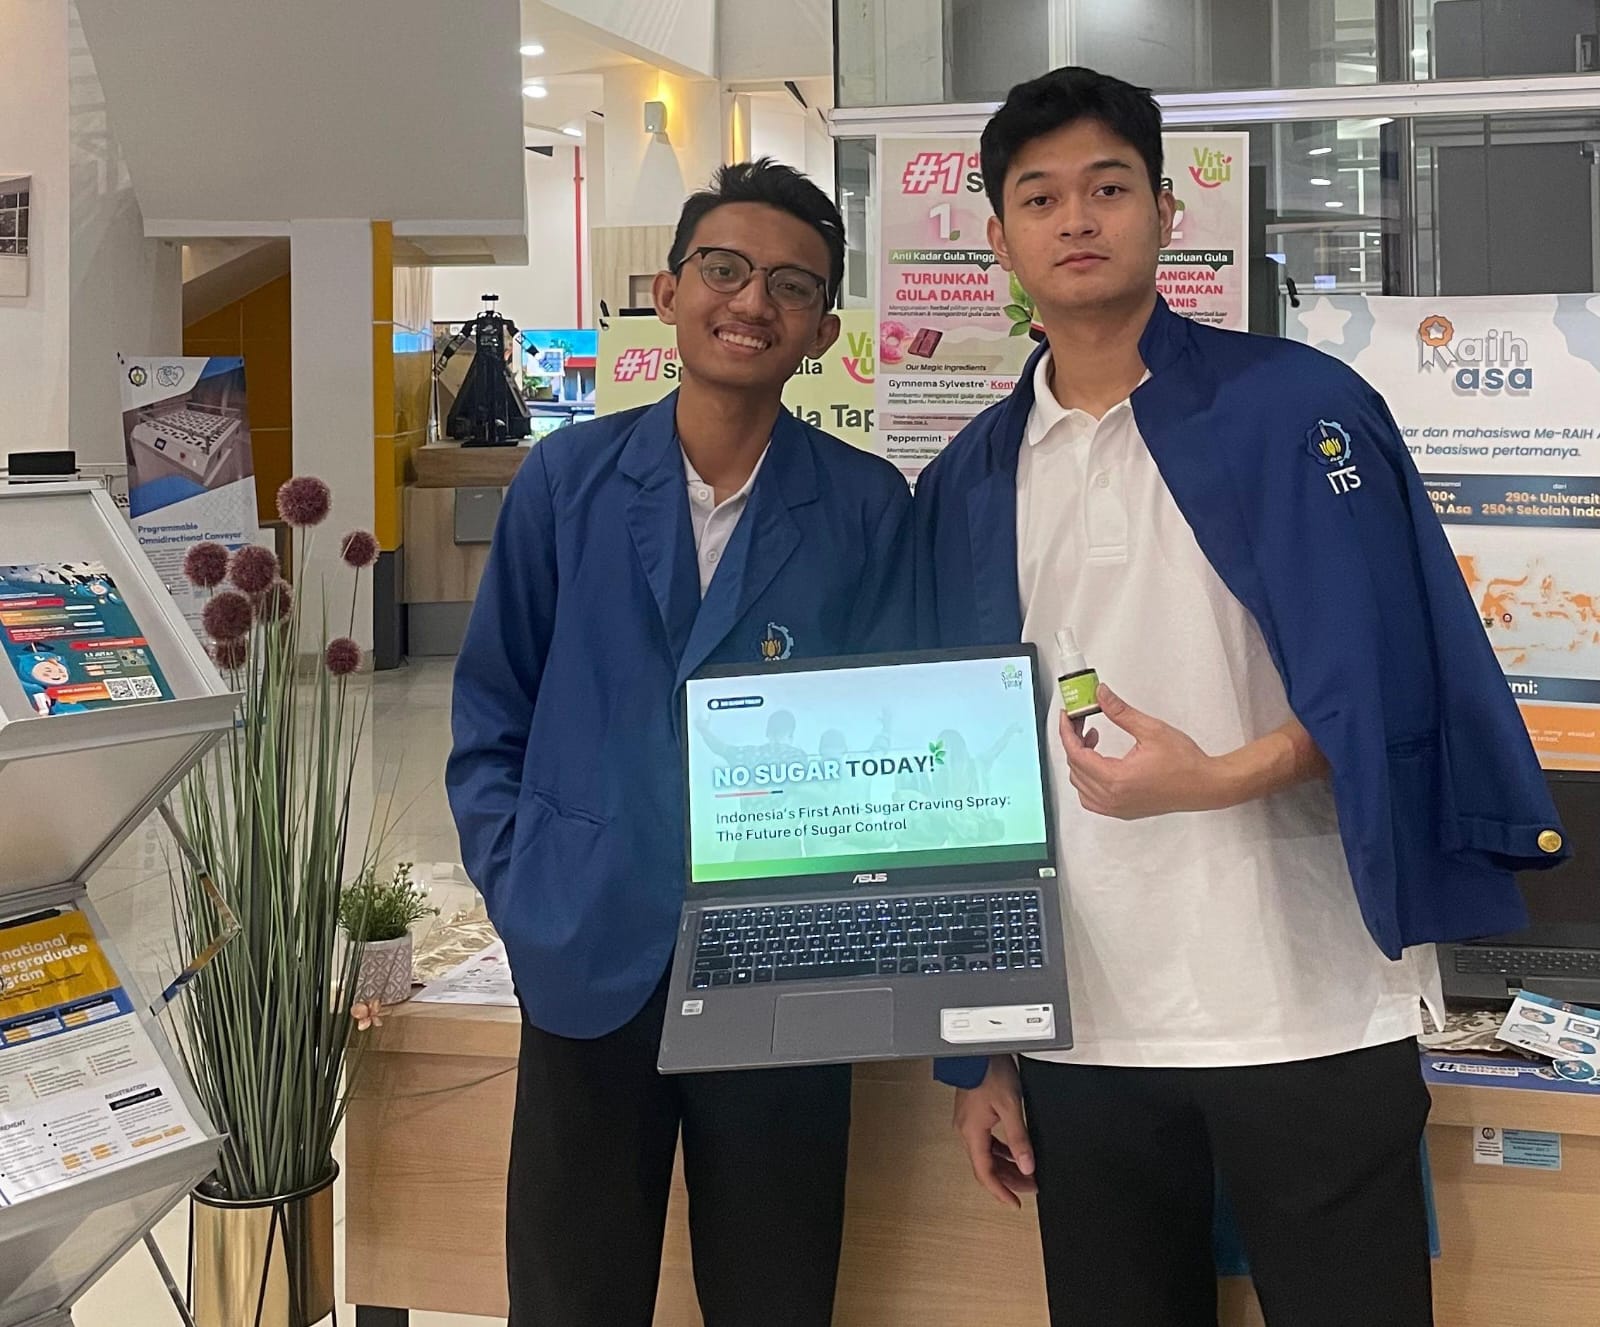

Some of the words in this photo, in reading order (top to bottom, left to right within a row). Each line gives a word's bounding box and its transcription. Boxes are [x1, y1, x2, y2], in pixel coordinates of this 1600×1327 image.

[902, 152, 964, 194] #1
[892, 252, 912, 261] Anti
[913, 252, 941, 261] Kadar
[943, 252, 966, 261] Gula
[1204, 252, 1229, 263] Gula
[902, 272, 989, 285] TURUNKAN
[896, 289, 938, 301] GULA
[941, 289, 994, 301] DARAH
[1175, 285, 1224, 295] MAKAN
[614, 348, 662, 382] #1
[921, 364, 943, 372] Magic
[944, 364, 987, 372] Ingredients
[888, 380, 937, 389] Gymnema
[1455, 367, 1533, 390] asa
[887, 434, 942, 443] Peppermint
[1422, 427, 1448, 438] dan
[1452, 427, 1530, 439] mahasiswa
[1534, 428, 1594, 439] Me-RAIH
[1425, 444, 1489, 455] beasiswa
[1491, 445, 1581, 459] pertamanya.
[1326, 465, 1362, 494] ITS
[1505, 491, 1537, 503] 290+
[1446, 503, 1473, 515] Asa
[1481, 503, 1514, 515] 250+
[1516, 505, 1570, 516] Sekolah
[138, 522, 199, 535] Programmable
[138, 533, 203, 545] Omnidirectional
[204, 531, 242, 541] Conveyor
[713, 766, 750, 787] NO
[754, 759, 840, 785] SUGAR
[845, 755, 935, 778] TODAY!
[799, 806, 829, 819] First
[908, 797, 963, 811] Craving
[716, 831, 743, 843] The
[746, 828, 791, 841] Future
[794, 824, 807, 837] of
[811, 823, 852, 838] Sugar
[855, 818, 907, 833] Control
[852, 873, 888, 884] ASUS
